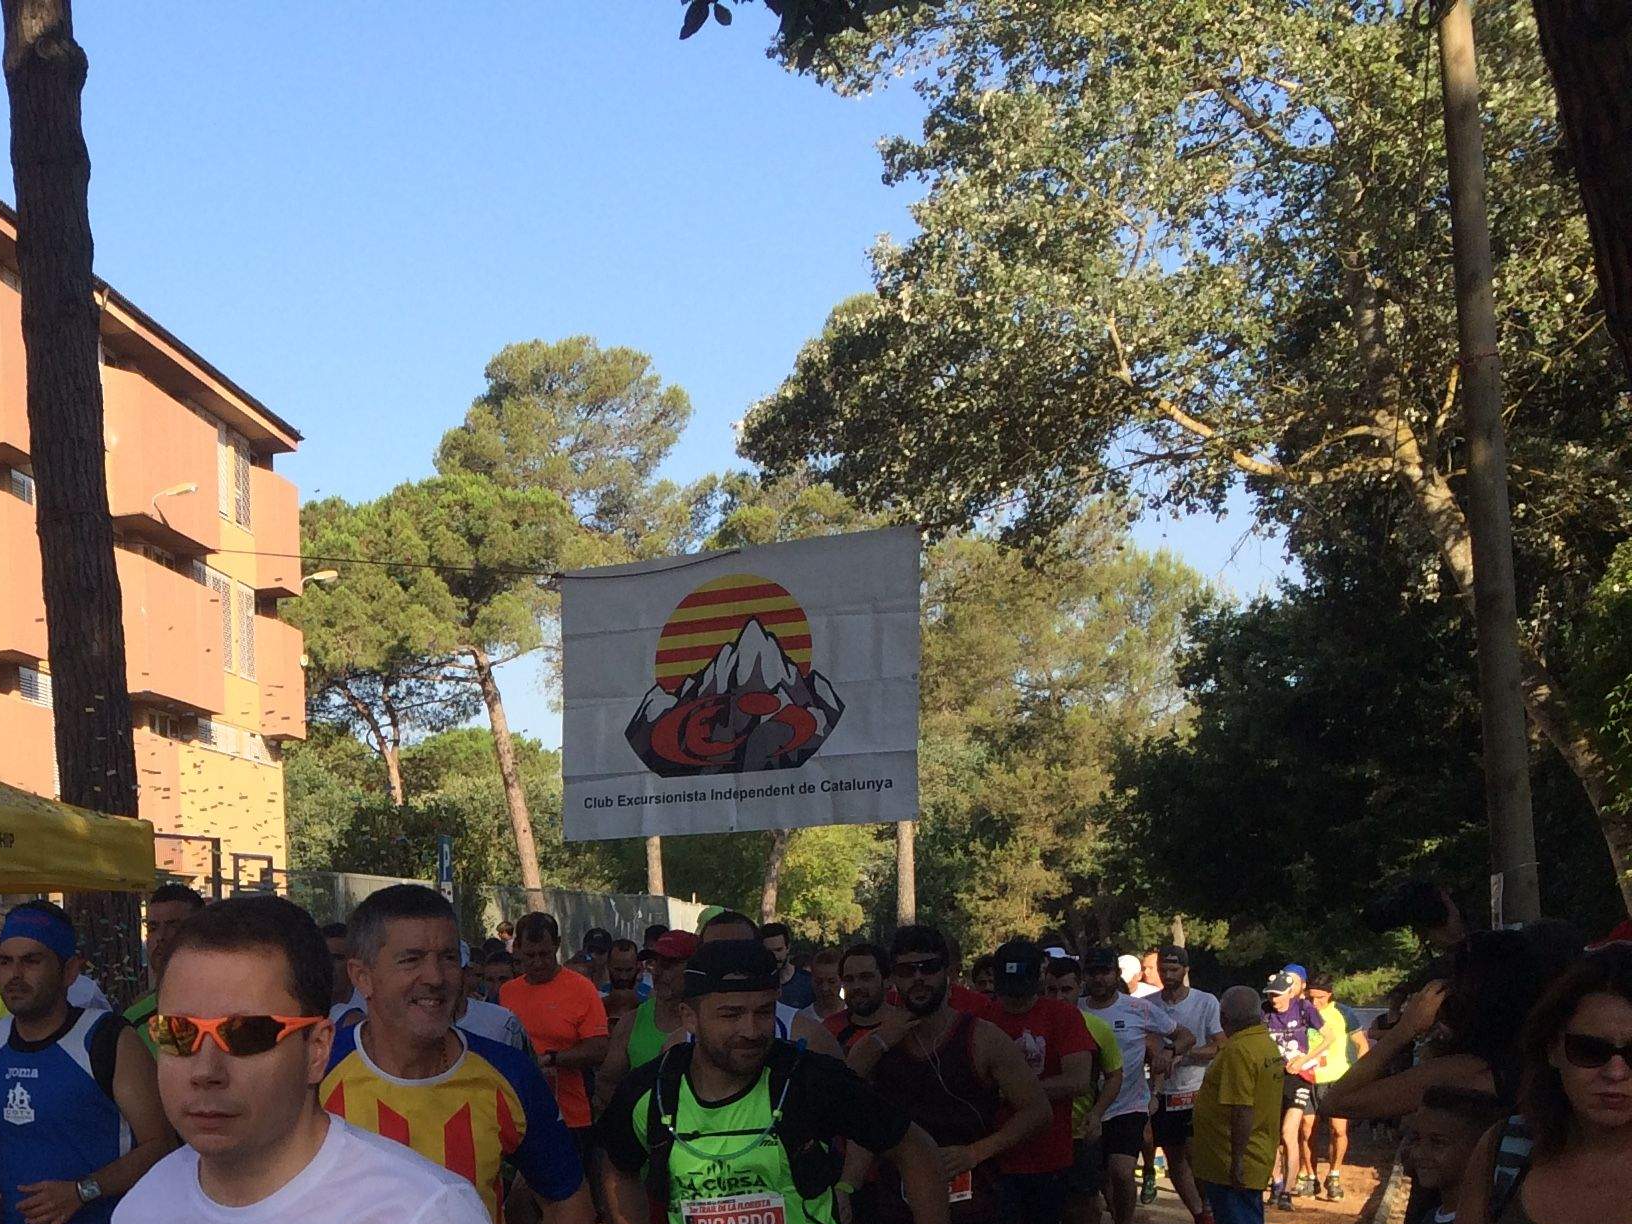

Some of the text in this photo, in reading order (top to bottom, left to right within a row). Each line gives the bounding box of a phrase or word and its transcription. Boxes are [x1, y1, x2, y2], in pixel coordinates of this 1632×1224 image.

[584, 776, 894, 810] Club Excursionista Independent de Catalunya
[703, 1174, 768, 1191] CURSA
